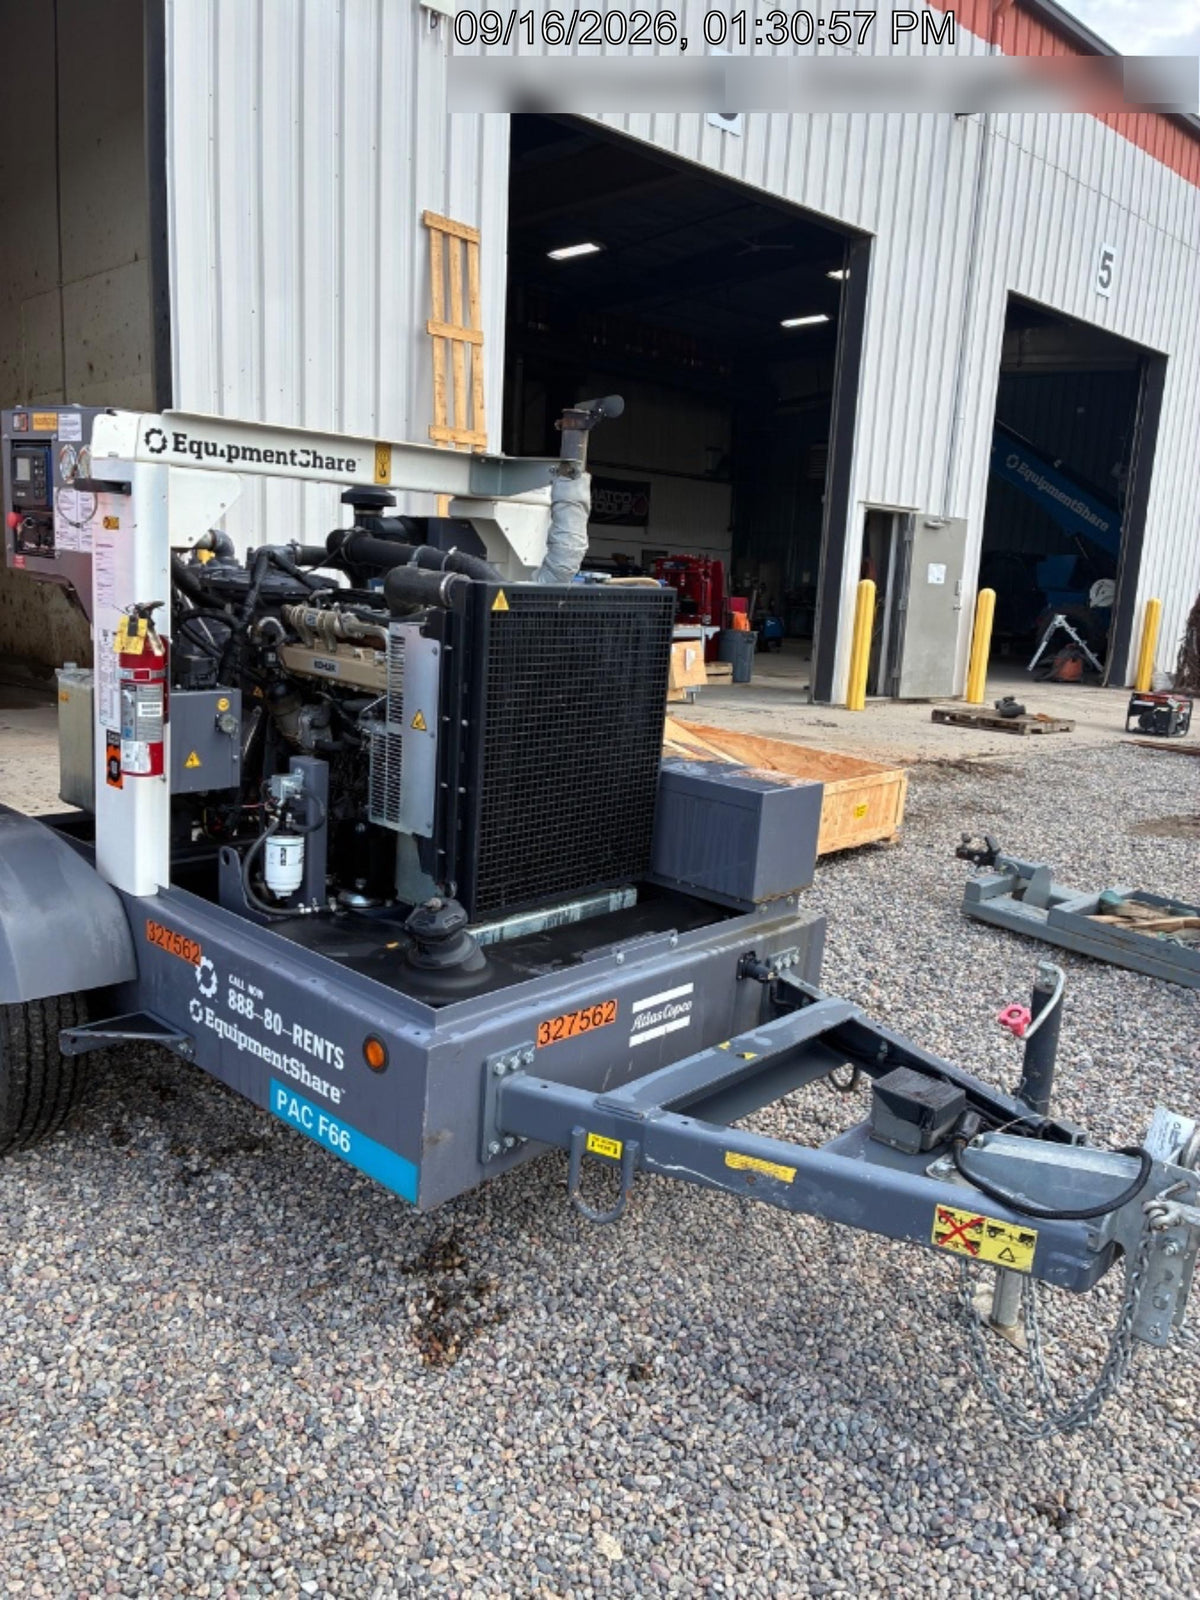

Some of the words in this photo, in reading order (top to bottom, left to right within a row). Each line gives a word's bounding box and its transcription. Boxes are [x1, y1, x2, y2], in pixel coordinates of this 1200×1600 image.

[1098, 250, 1114, 289] 5
[1016, 462, 1109, 532] EquipmentShare
[148, 920, 200, 966] 327562
[228, 974, 246, 991] CALL
[228, 988, 345, 1070] 888-80-RENTS
[539, 1000, 616, 1044] 327562
[204, 1007, 341, 1104] EquipmentShare
[277, 1089, 313, 1130] PAC
[318, 1114, 351, 1153] F66
